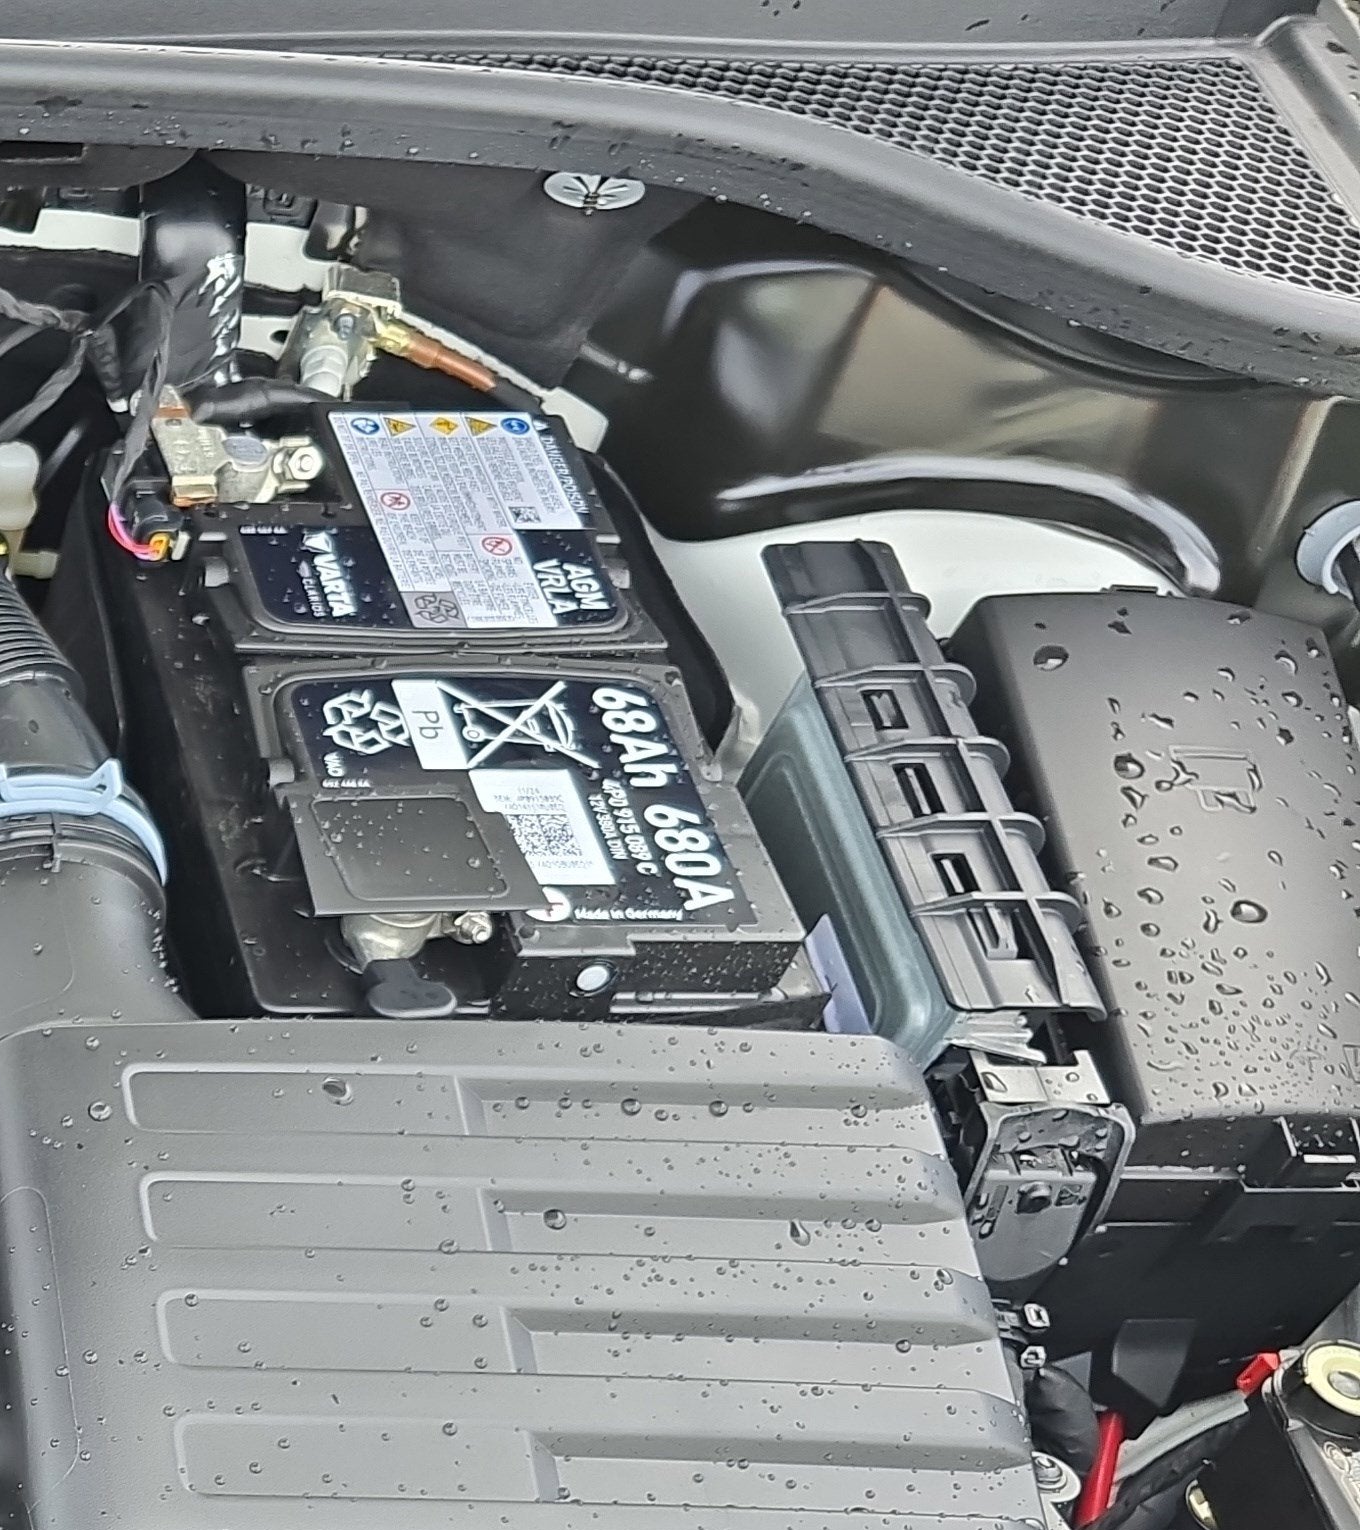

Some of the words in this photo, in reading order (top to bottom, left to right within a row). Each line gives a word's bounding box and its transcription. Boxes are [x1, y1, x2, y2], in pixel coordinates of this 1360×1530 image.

[541, 436, 590, 514] DANGER/POISON
[302, 577, 327, 618] CLARIOS
[313, 552, 357, 618] VARTA
[533, 558, 580, 614] VRLA
[562, 562, 611, 610] AGM
[410, 707, 440, 742] Pb
[592, 687, 679, 788] 68Ah
[643, 804, 735, 912] 680A
[613, 807, 641, 835] 915
[607, 839, 629, 861] DIN
[625, 834, 653, 861] 089
[636, 861, 659, 877] C
[610, 909, 624, 920] in
[625, 907, 684, 921] Germany
